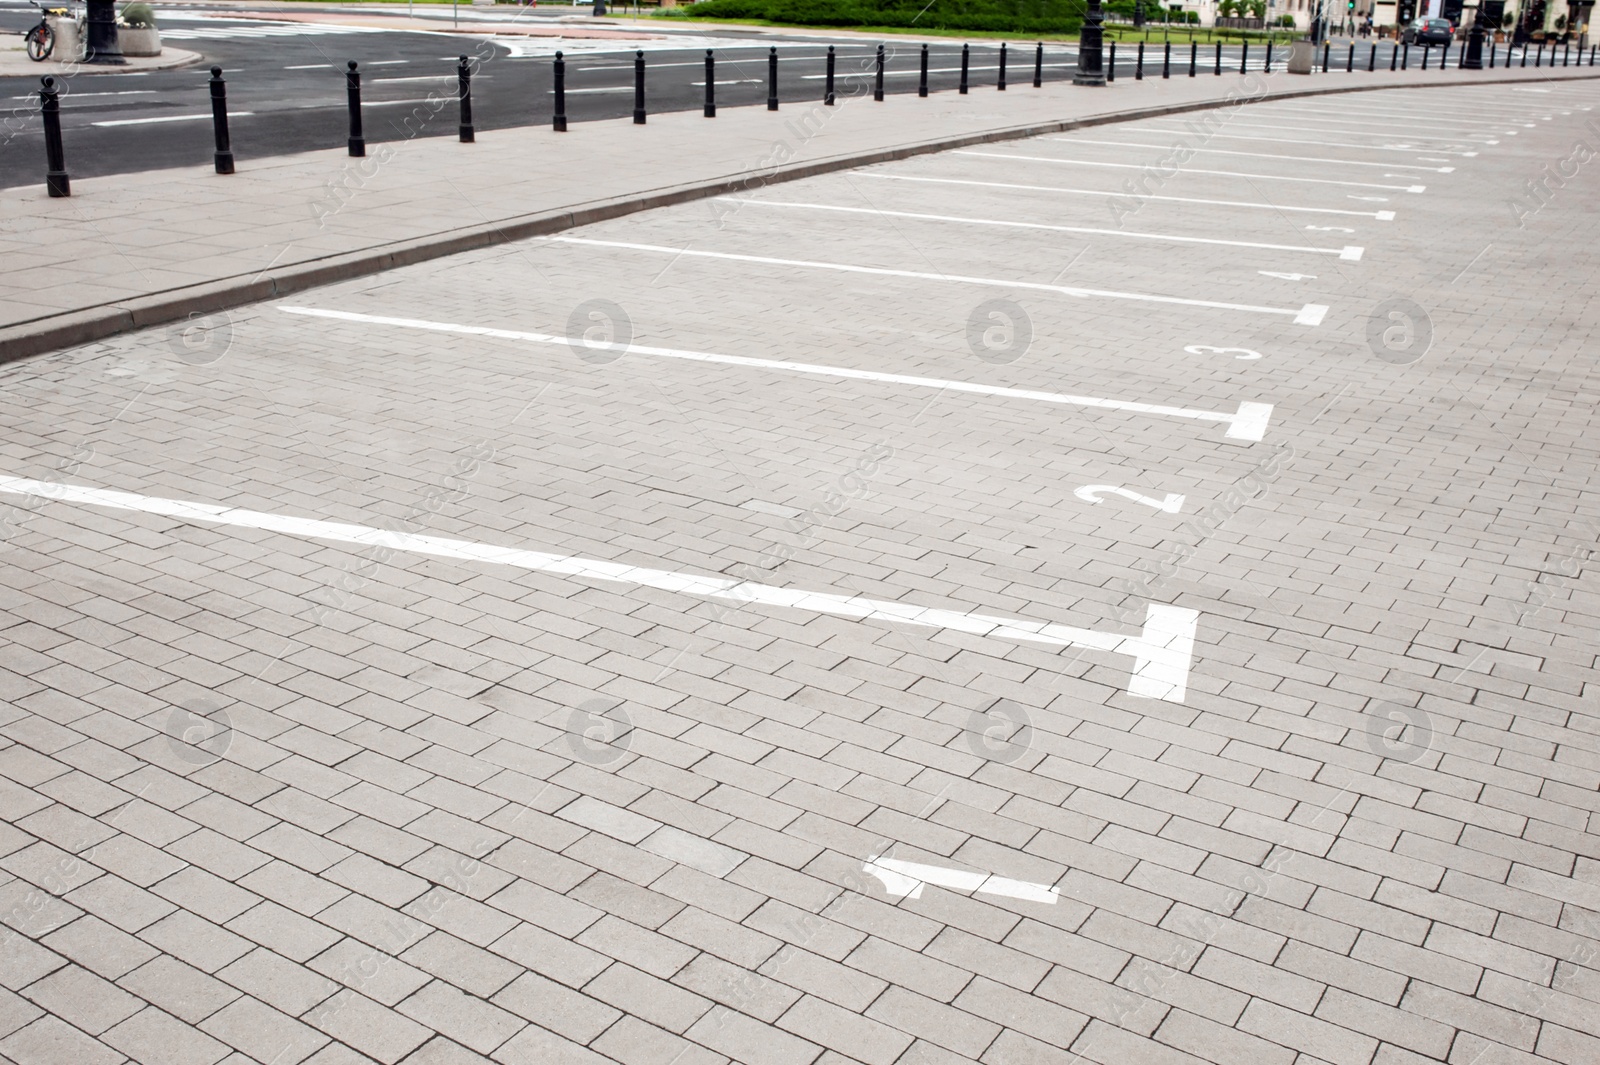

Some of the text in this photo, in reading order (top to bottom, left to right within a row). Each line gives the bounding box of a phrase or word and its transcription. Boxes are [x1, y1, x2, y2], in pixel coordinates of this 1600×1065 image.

[1258, 270, 1318, 281] 4
[1184, 344, 1262, 360] 3
[1073, 484, 1186, 513] 2
[863, 856, 1061, 904] 1
